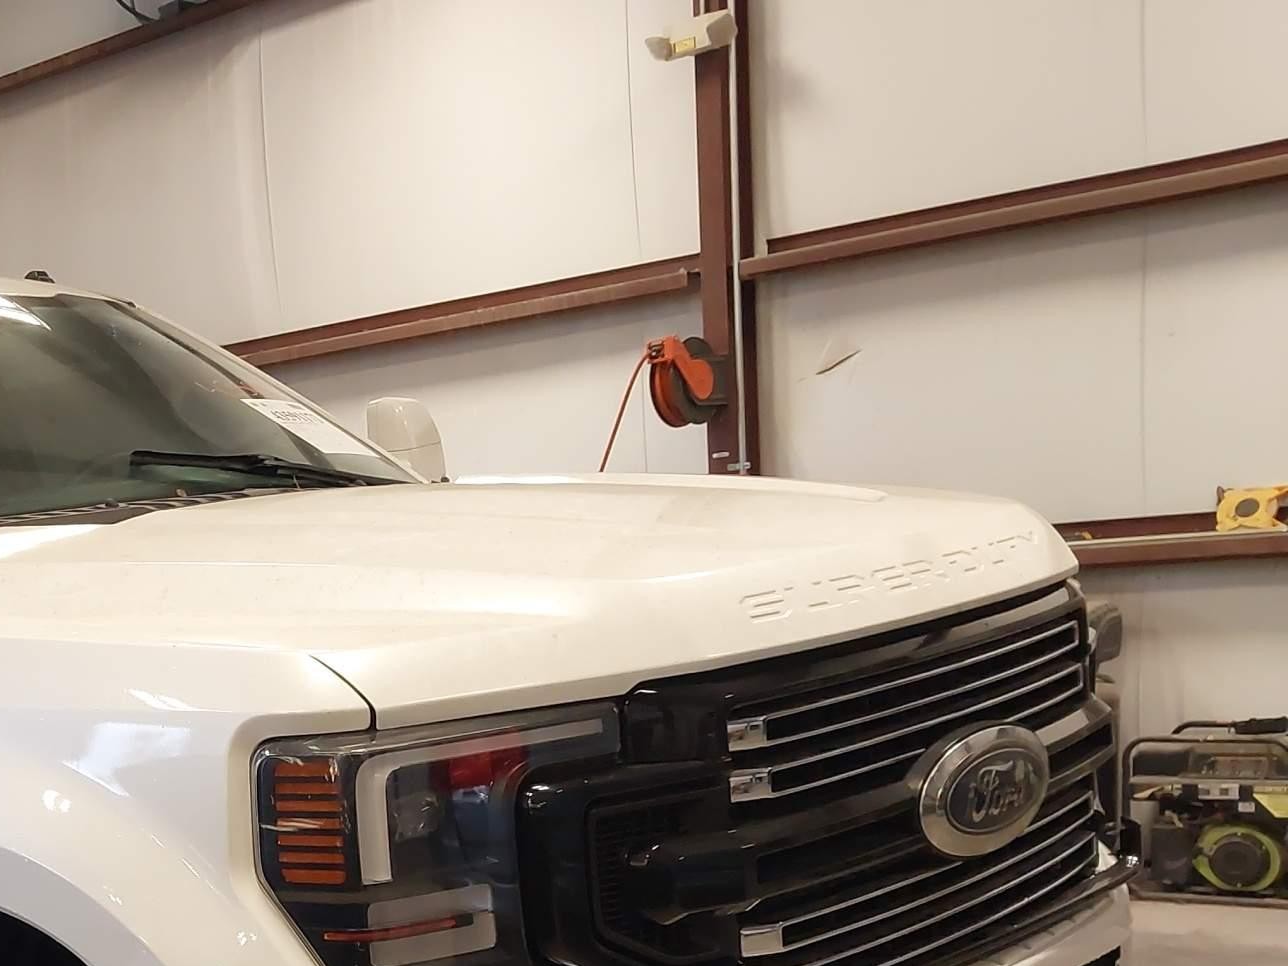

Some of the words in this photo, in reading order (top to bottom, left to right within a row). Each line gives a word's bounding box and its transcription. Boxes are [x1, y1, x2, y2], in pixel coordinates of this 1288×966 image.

[738, 558, 952, 624] SUPER
[940, 530, 1040, 578] DUTY
[968, 758, 1038, 823] Ford
